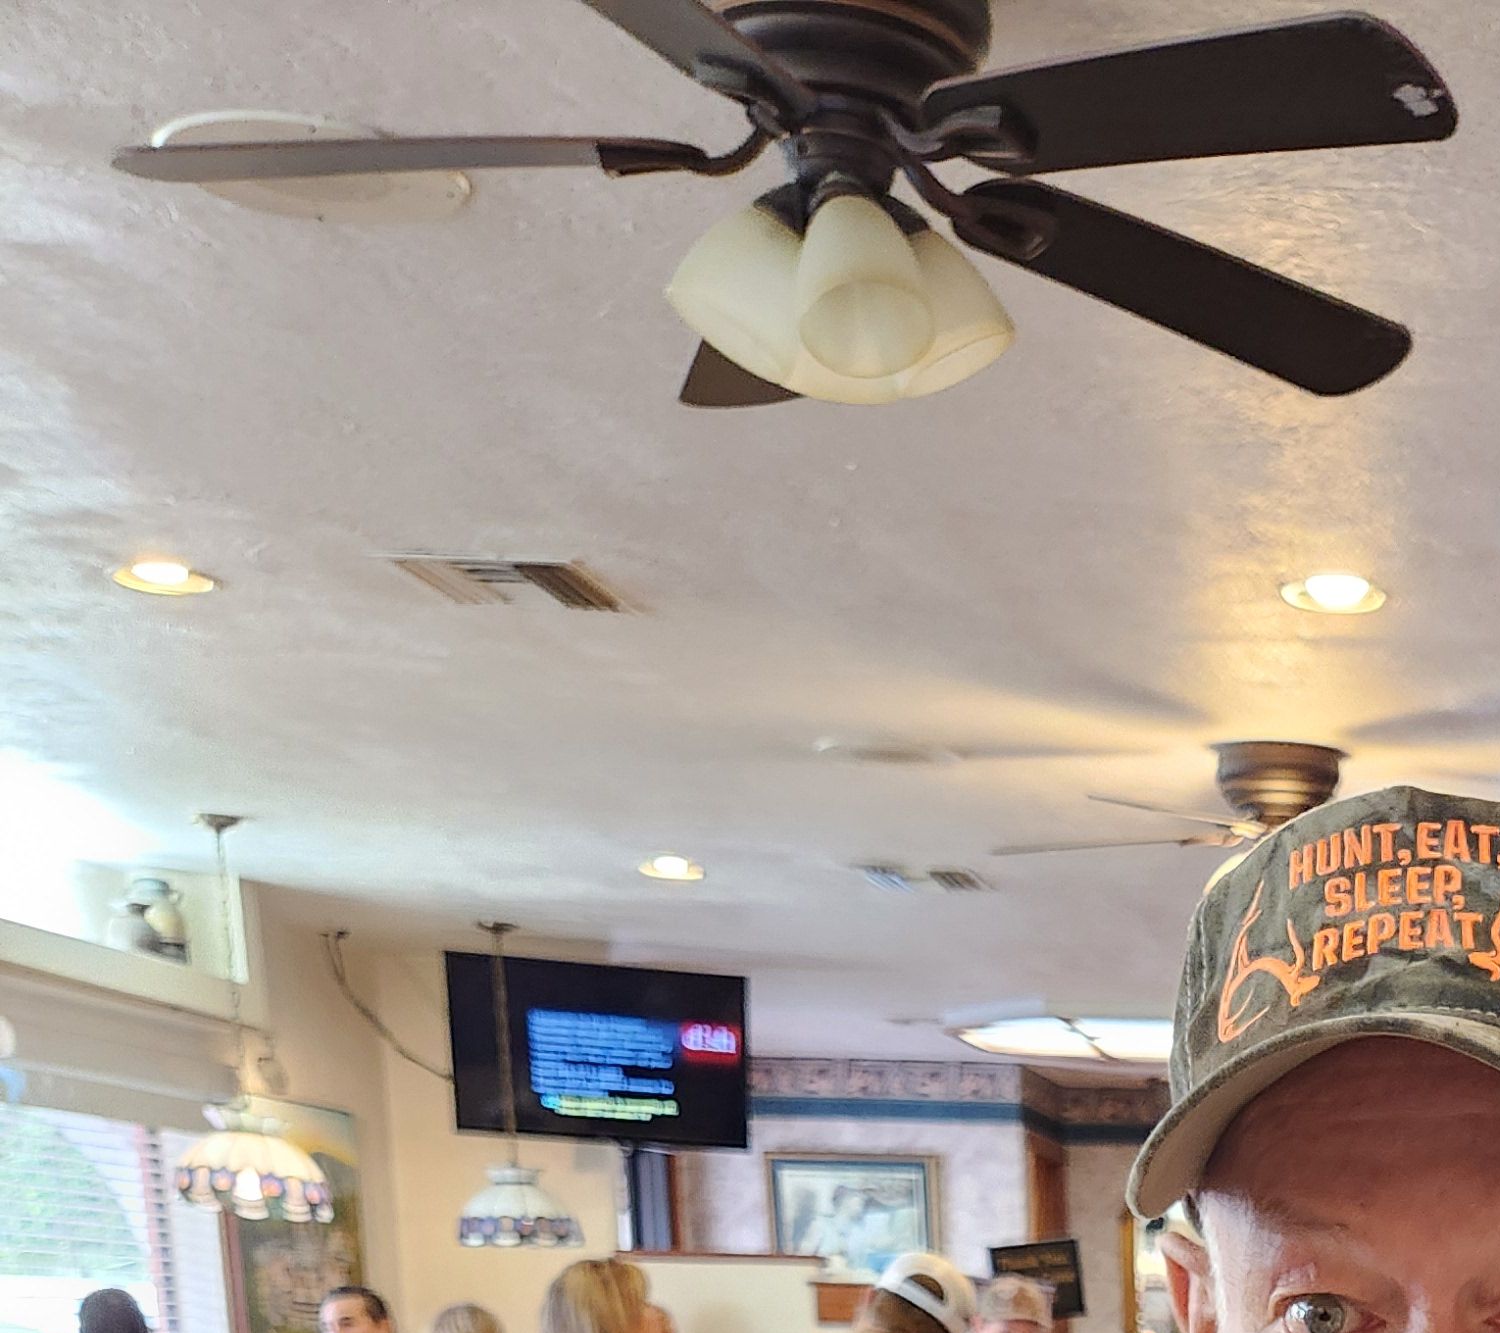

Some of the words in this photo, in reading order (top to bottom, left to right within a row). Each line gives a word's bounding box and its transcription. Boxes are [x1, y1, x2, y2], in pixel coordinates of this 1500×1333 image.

[1288, 823, 1412, 890] HUNT,
[1324, 864, 1466, 918] SLEEP,
[1311, 908, 1484, 972] REPEAT
